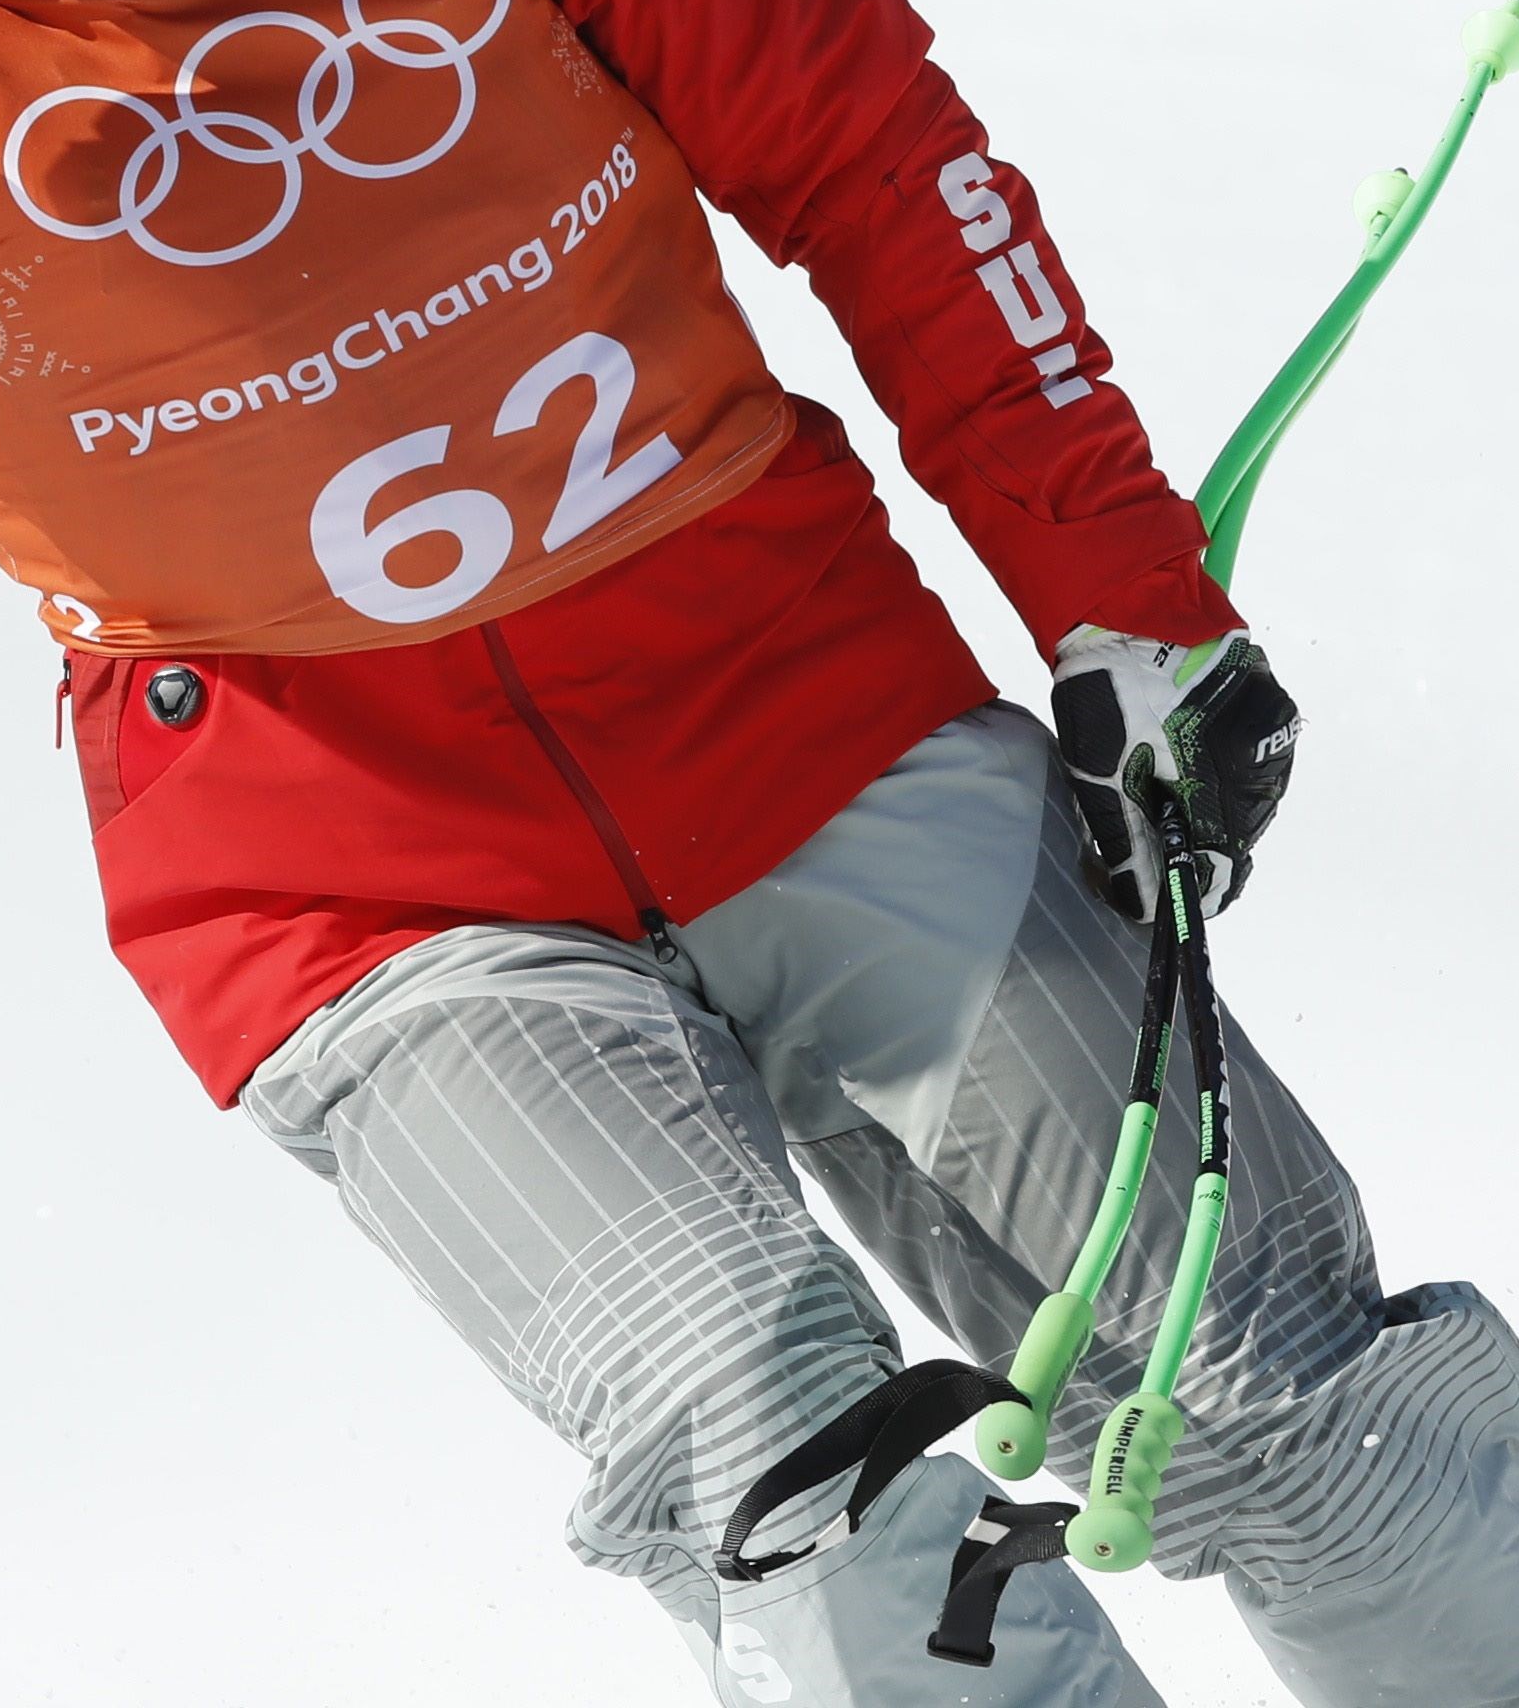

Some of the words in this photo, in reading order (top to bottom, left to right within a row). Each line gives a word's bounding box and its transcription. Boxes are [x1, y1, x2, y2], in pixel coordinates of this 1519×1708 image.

[69, 237, 553, 456] PyeongChang
[309, 331, 683, 624] 62
[1168, 868, 1190, 944] KOMPERDELL
[1199, 1090, 1214, 1164] KOMPERDELL
[1104, 1406, 1144, 1496] KOMPERDELL
